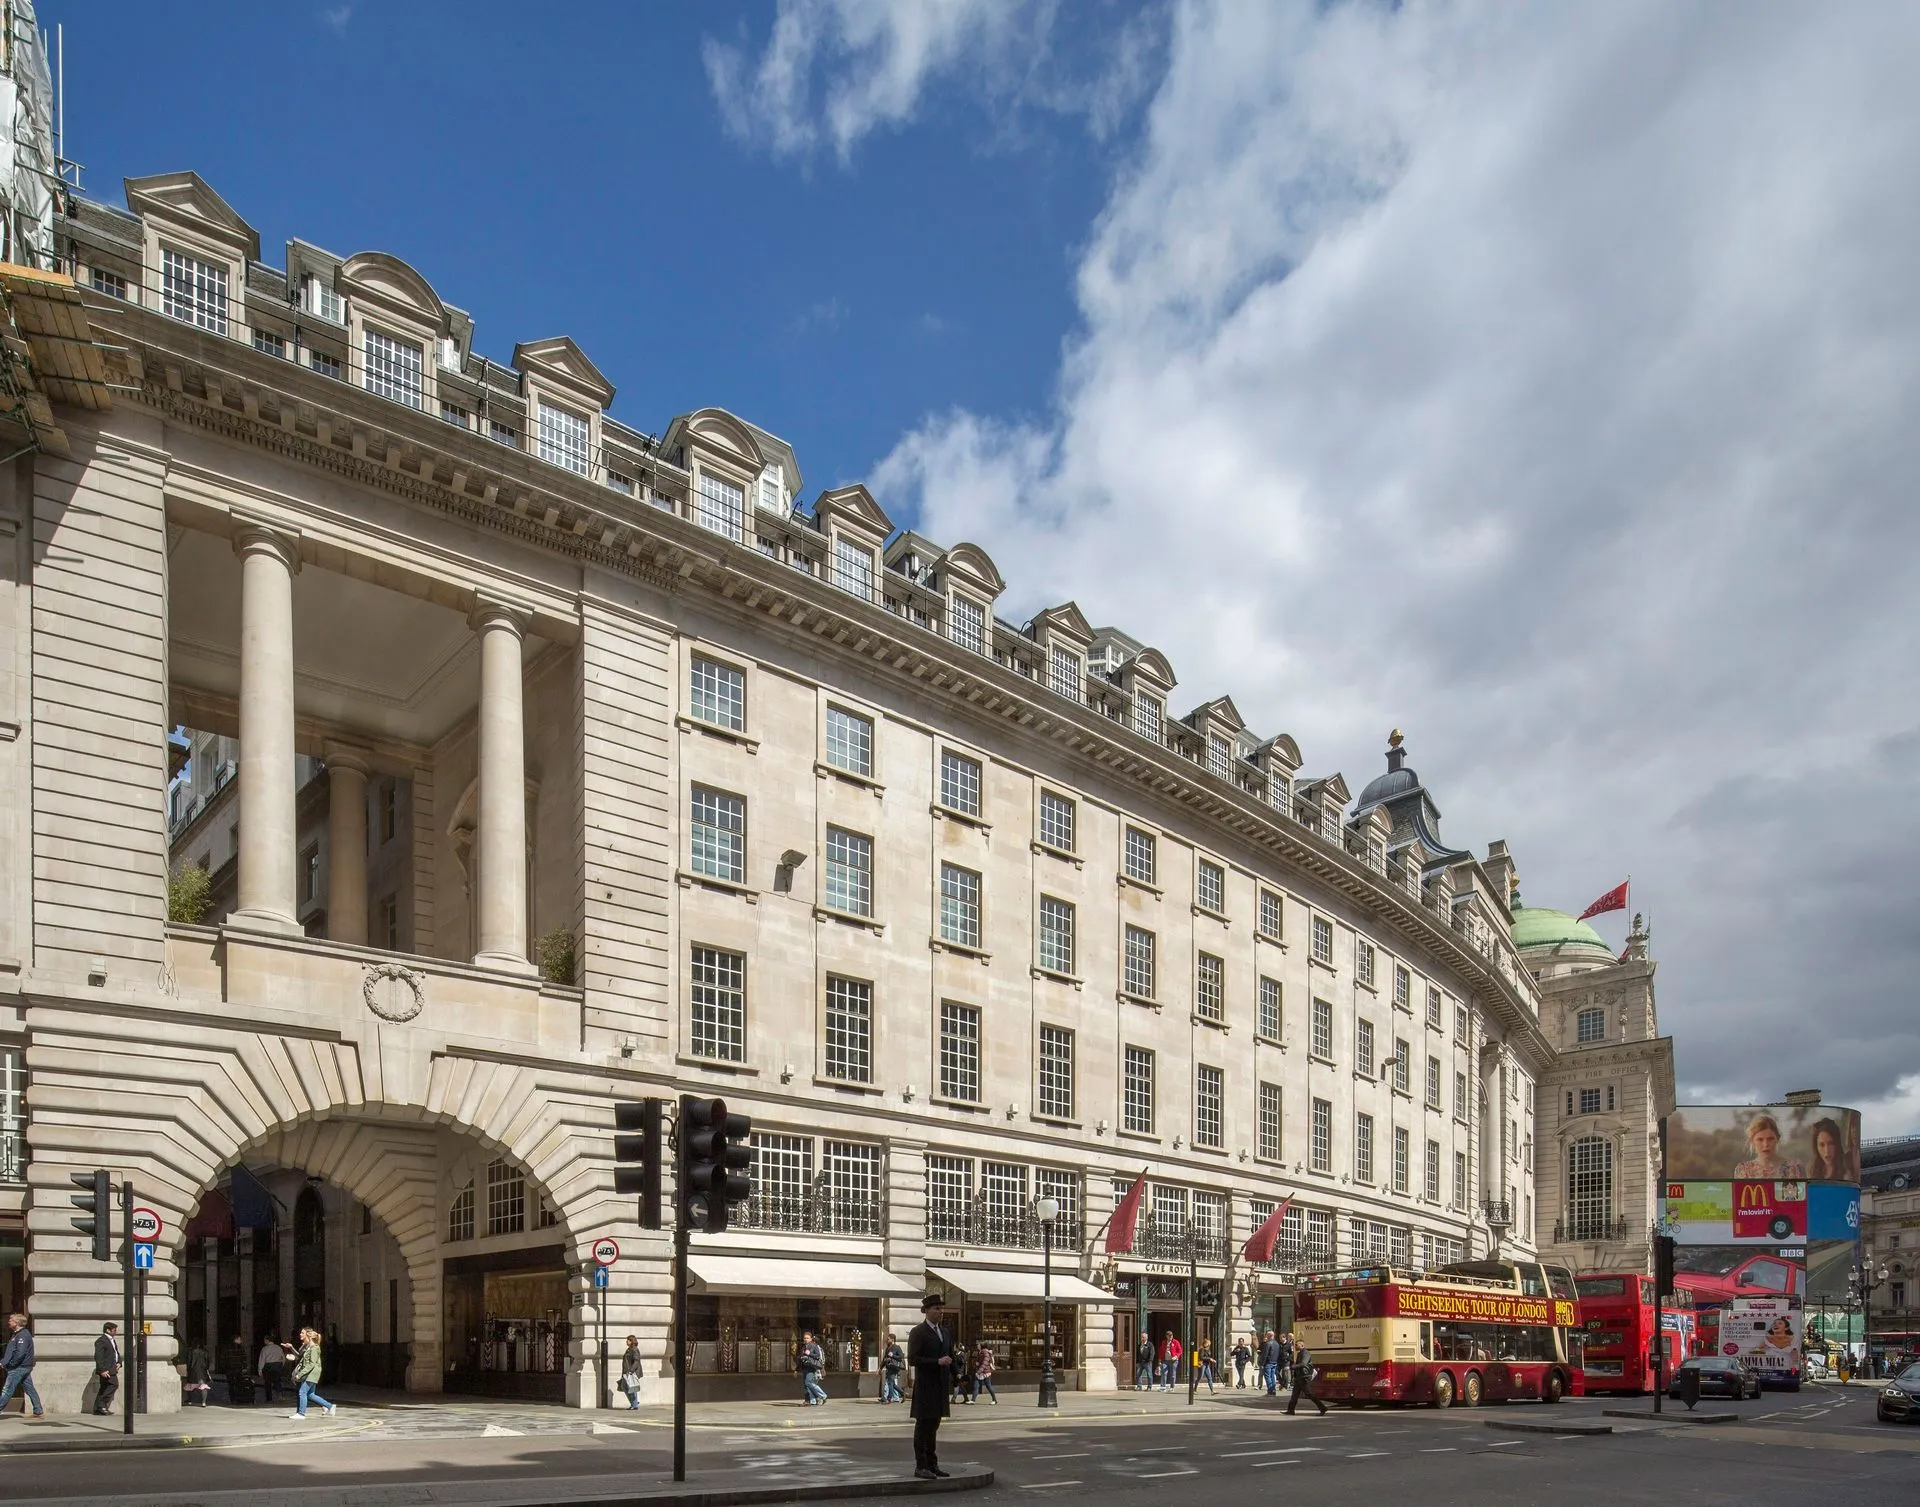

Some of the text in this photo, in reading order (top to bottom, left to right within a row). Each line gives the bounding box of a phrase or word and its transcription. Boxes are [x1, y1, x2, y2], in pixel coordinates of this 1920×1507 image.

[1781, 1249, 1804, 1258] BBC
[1169, 1264, 1191, 1274] ROYA
[1318, 1298, 1338, 1310] BIG
[1399, 1293, 1547, 1319] SIGHTSEEING TOUR OF LONDON
[1555, 1301, 1566, 1313] BIG
[1318, 1310, 1338, 1320] BUS
[1556, 1313, 1566, 1325] BUS
[1587, 1321, 1601, 1329] 159
[1766, 1357, 1784, 1367] MIA!
